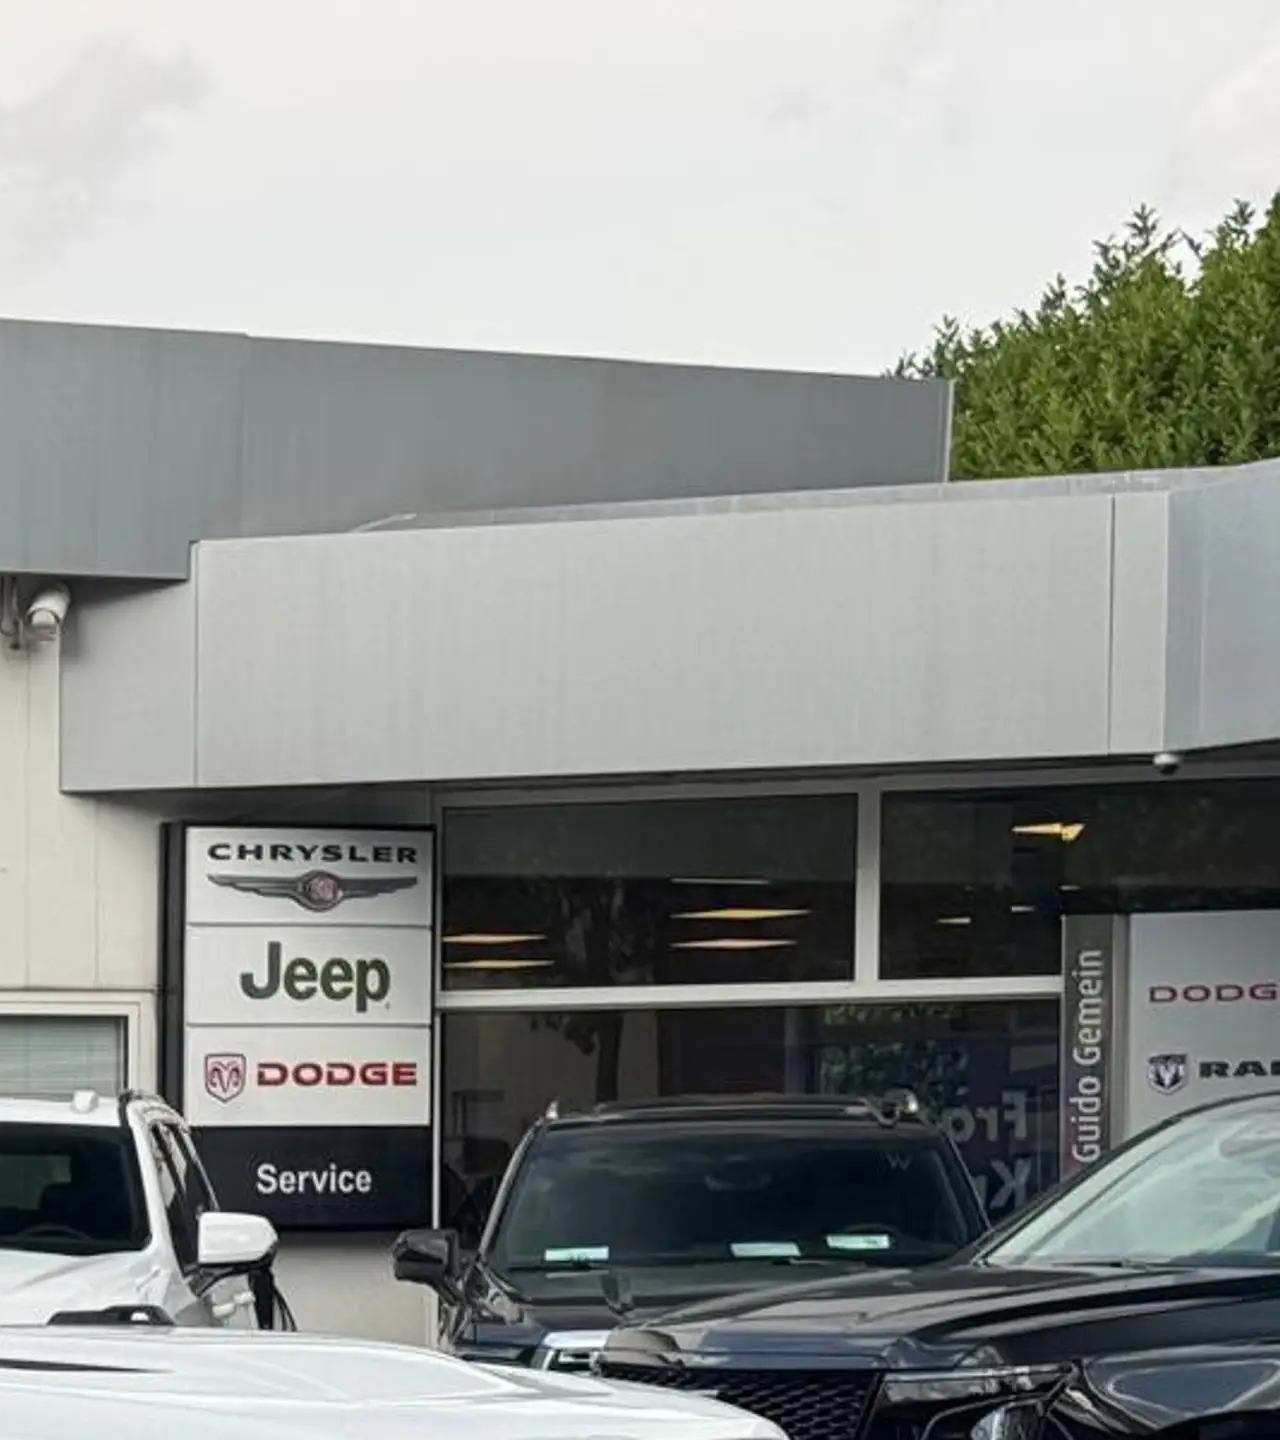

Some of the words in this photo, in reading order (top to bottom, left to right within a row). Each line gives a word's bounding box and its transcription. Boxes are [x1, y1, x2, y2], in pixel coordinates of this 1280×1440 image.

[206, 843, 418, 863] CHRYSLER
[240, 941, 390, 1012] Jeep
[1148, 982, 1278, 1003] DODG
[1071, 949, 1104, 1066] Gemein
[256, 1062, 418, 1087] DODGE
[1198, 1059, 1280, 1078] RA
[1068, 1075, 1102, 1163] Guido
[256, 1163, 372, 1194] Service
